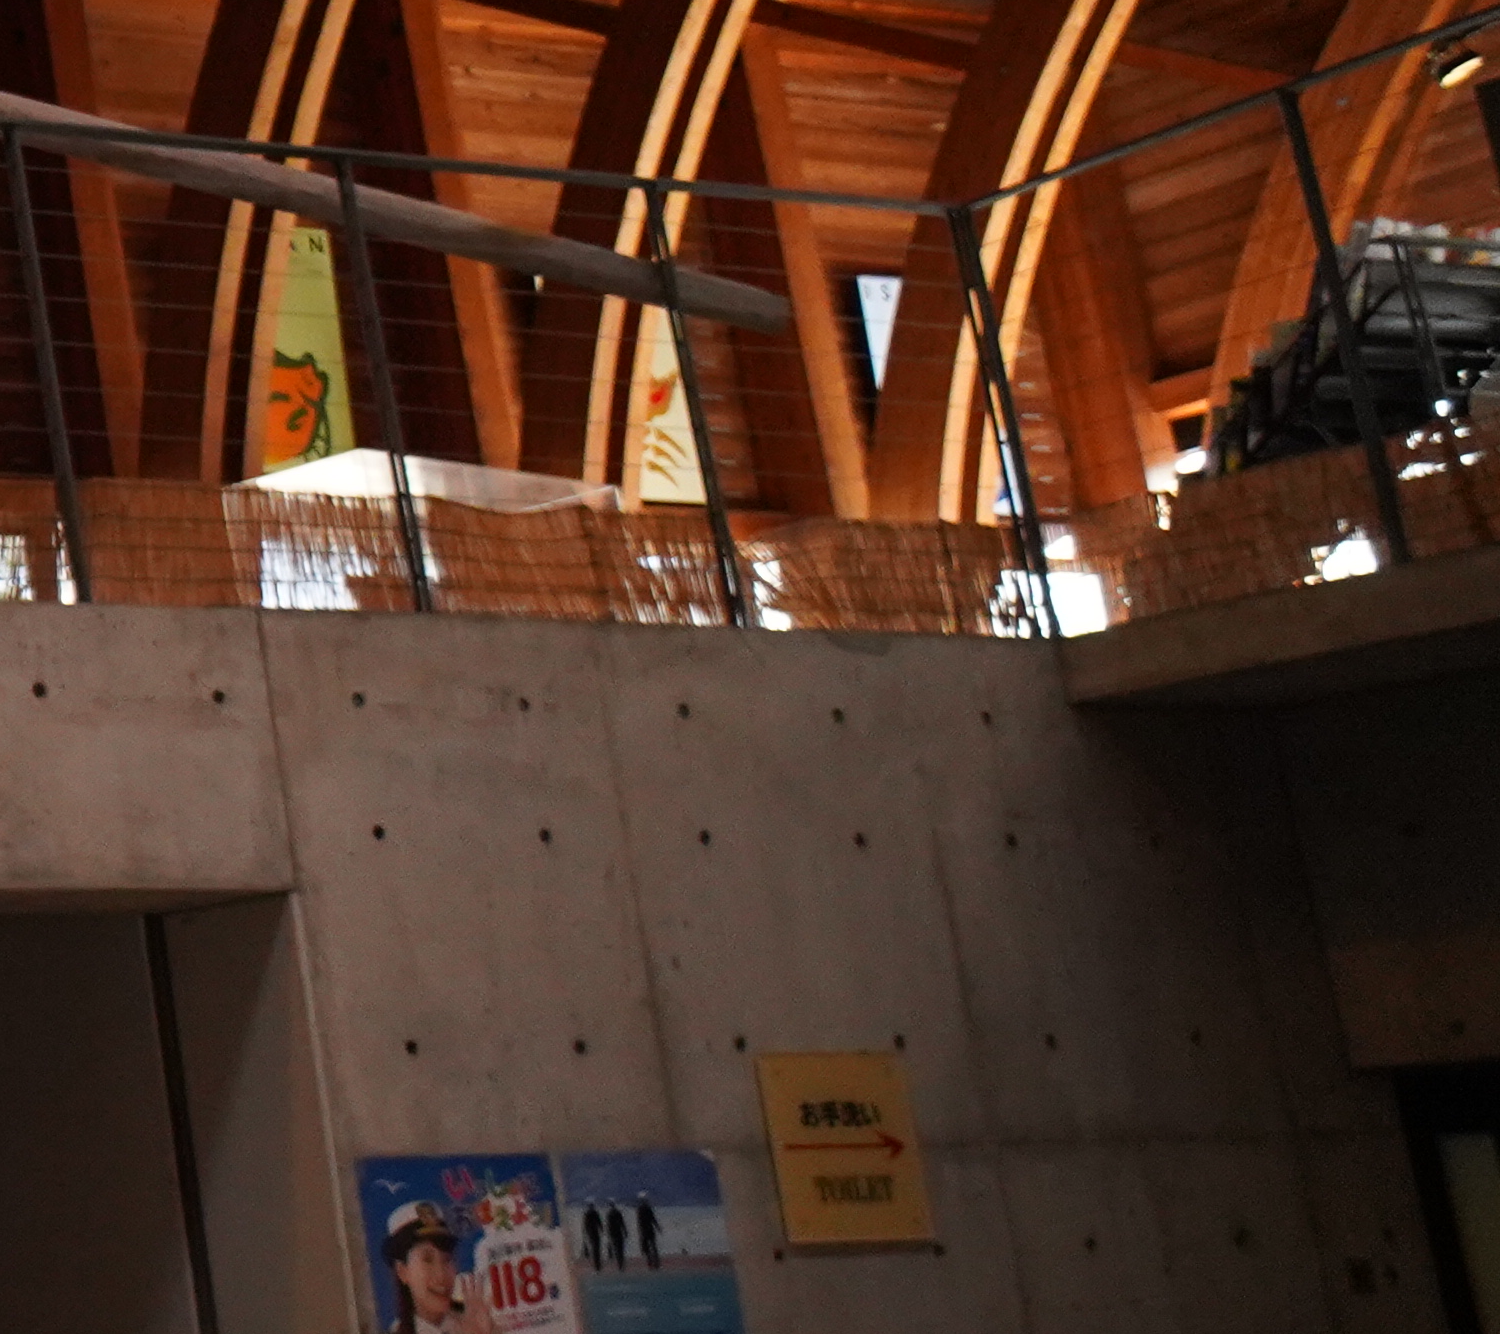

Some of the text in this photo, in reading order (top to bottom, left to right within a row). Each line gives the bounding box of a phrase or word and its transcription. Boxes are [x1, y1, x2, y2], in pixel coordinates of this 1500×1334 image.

[797, 1100, 882, 1128] お手洗い
[812, 1175, 893, 1203] TOILET
